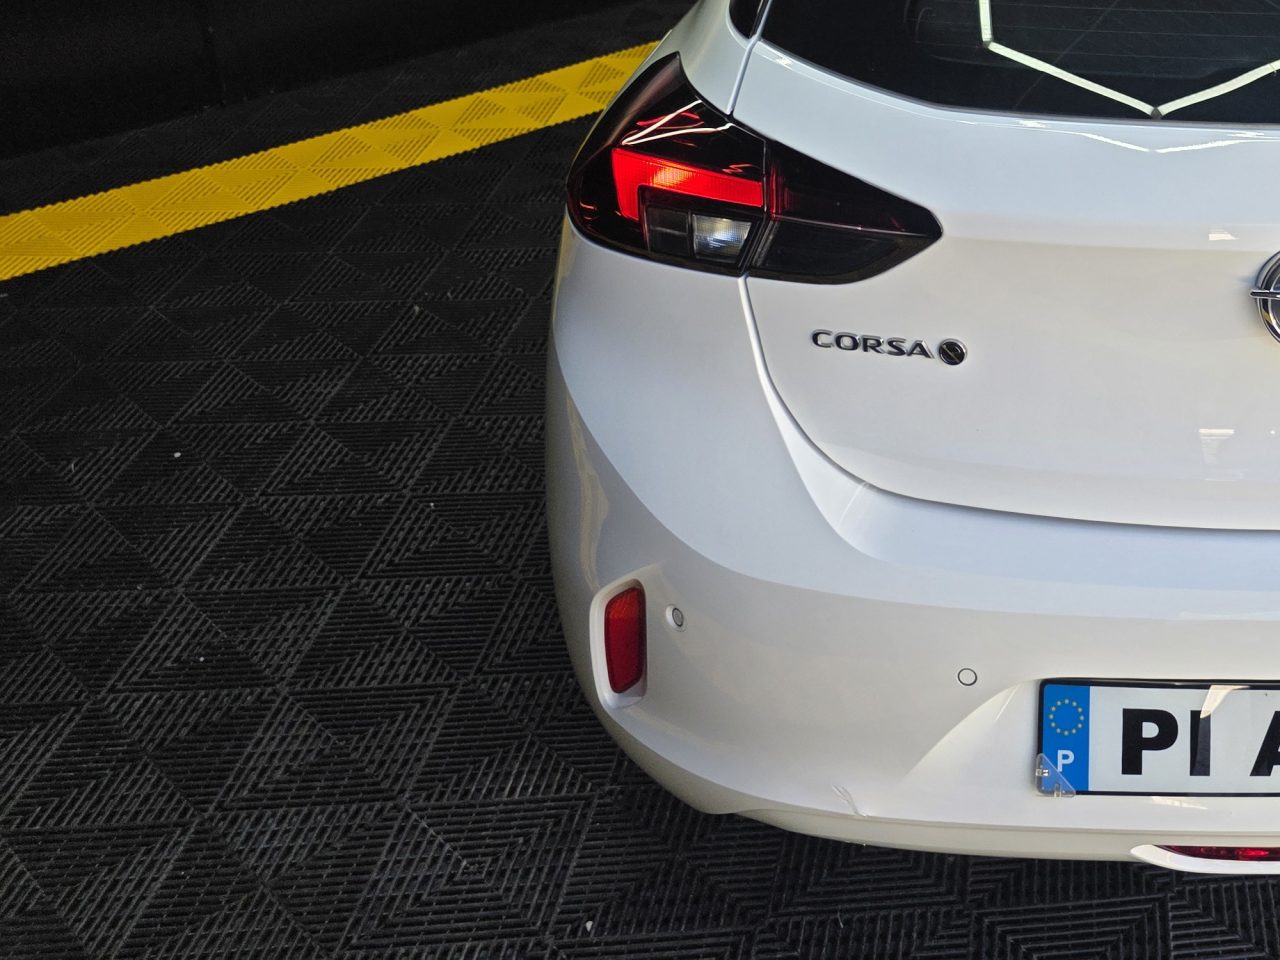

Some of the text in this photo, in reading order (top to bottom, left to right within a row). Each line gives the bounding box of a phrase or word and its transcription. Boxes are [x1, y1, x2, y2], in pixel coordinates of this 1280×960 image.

[811, 328, 935, 359] CORSA
[1121, 707, 1212, 777] PI
[1057, 749, 1075, 772] P
